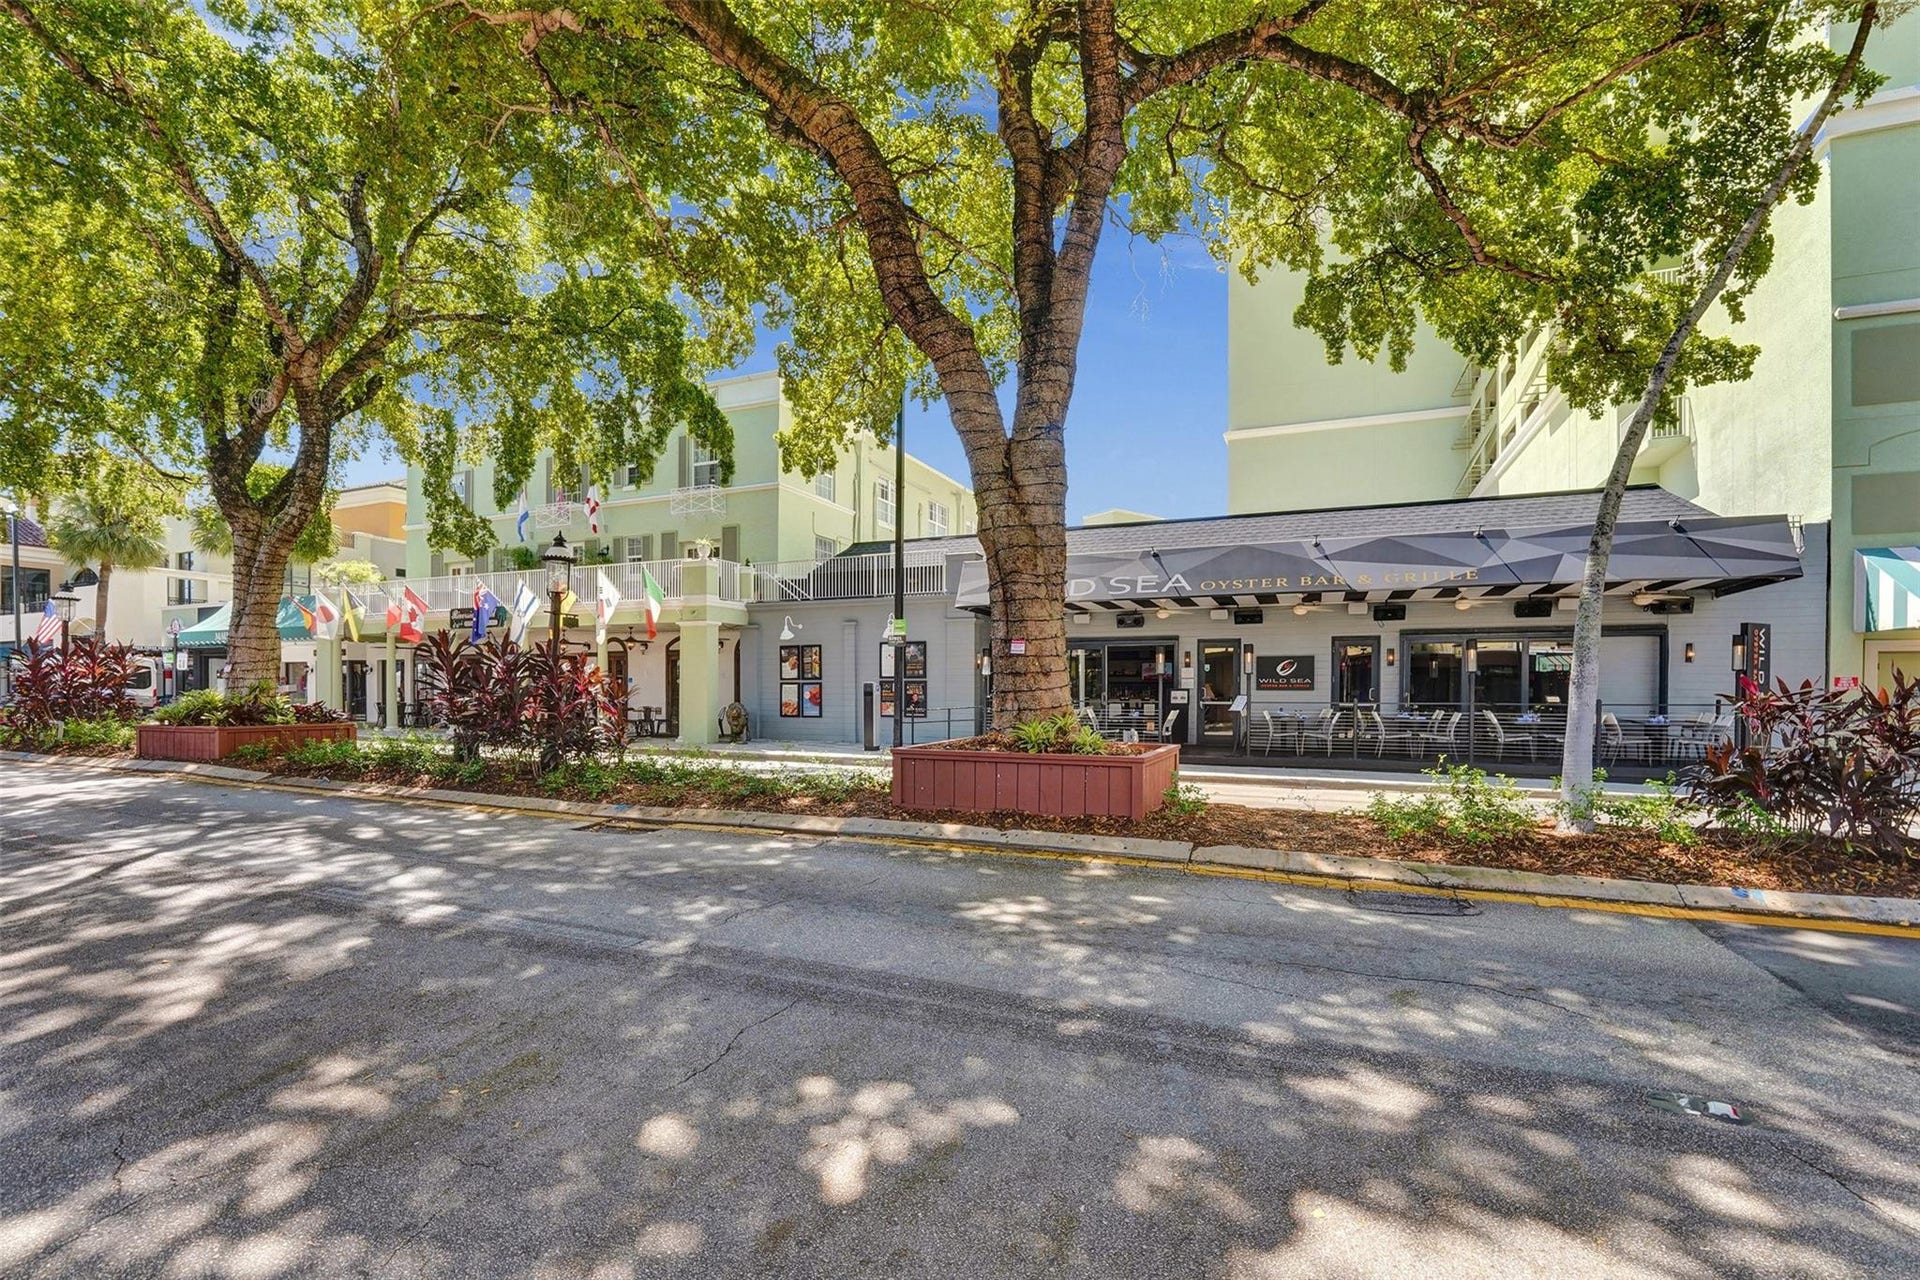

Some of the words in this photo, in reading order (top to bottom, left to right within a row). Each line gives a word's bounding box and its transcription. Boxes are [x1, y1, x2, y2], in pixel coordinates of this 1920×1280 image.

[1108, 573, 1193, 595] SEA
[1200, 577, 1289, 590] OYSTER
[1300, 574, 1347, 586] BAR
[1357, 574, 1374, 585] &
[1383, 568, 1479, 583] GRILLE
